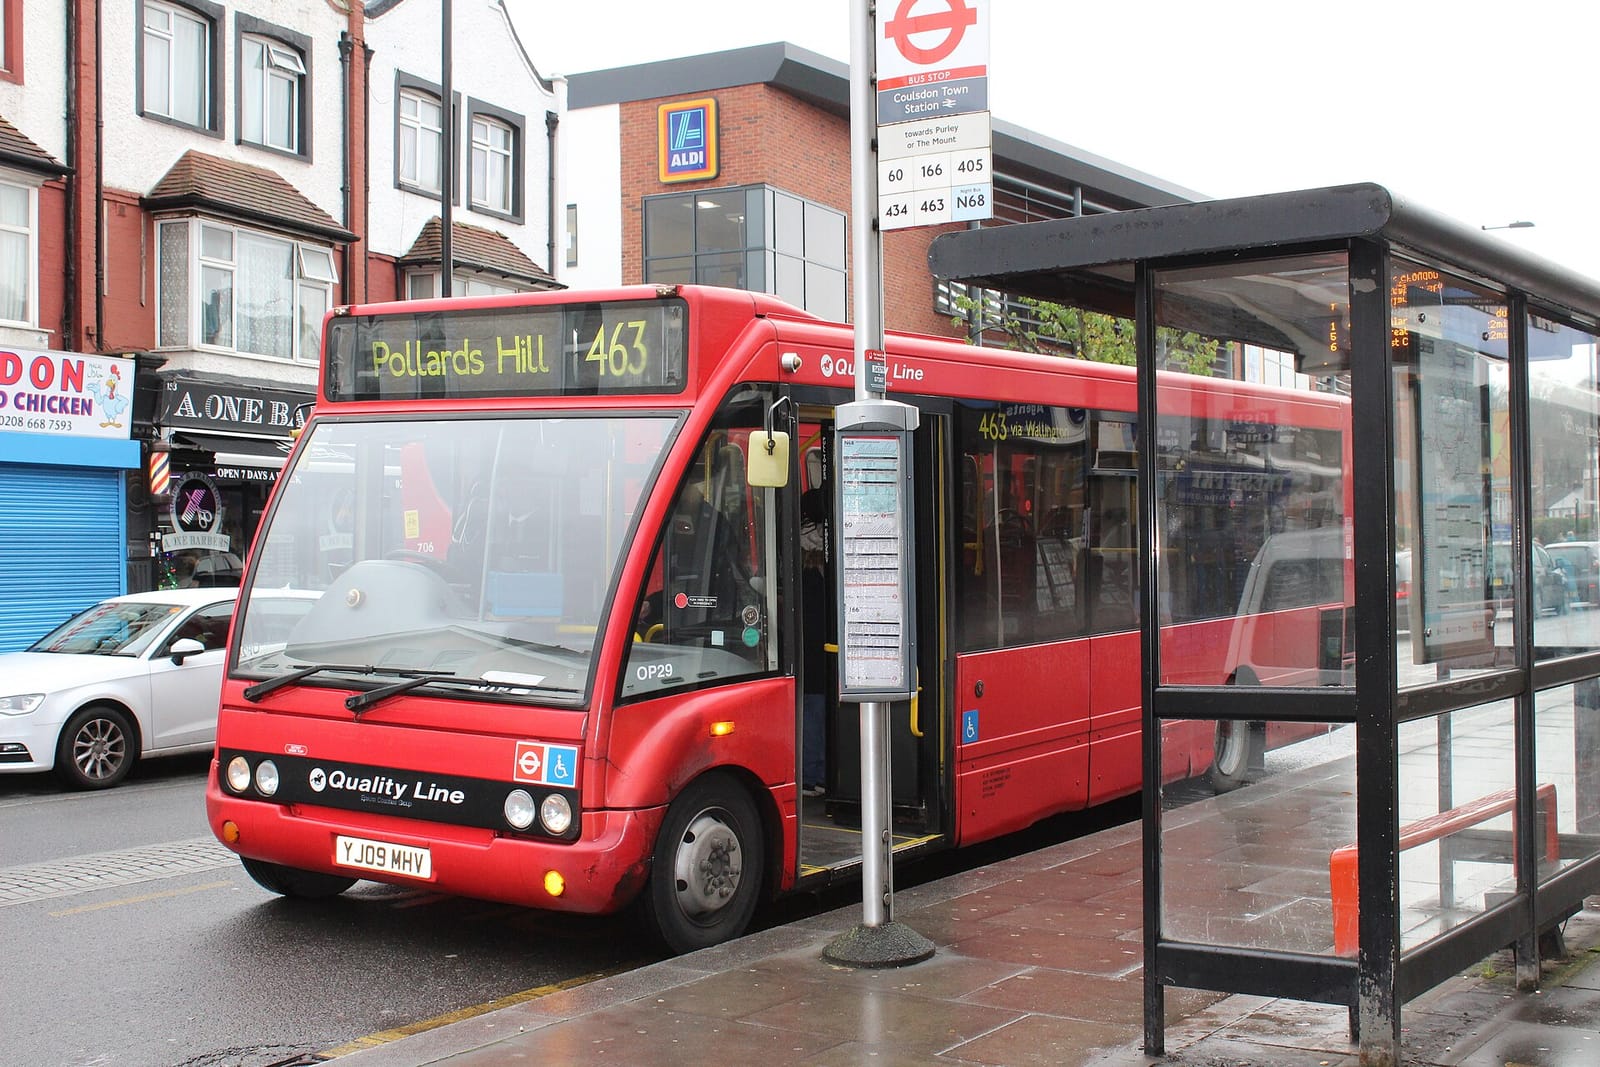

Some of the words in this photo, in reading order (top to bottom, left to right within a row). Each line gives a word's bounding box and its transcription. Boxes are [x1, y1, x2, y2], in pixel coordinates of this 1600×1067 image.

[908, 75, 925, 84] BUS
[928, 72, 951, 83] STOP
[893, 90, 939, 103] Coulsdon
[942, 85, 969, 97] Town
[905, 101, 939, 114] Station
[905, 127, 933, 138] towards
[935, 125, 959, 136] Purley
[917, 138, 930, 147] The
[932, 136, 956, 146] Mount
[671, 150, 704, 168] ALDI
[888, 169, 904, 182] 60
[921, 164, 943, 178] 166
[958, 158, 983, 173] 405
[885, 204, 908, 217] 434
[920, 198, 945, 213] 463
[957, 194, 985, 208] N68
[372, 339, 485, 377] Pollards
[496, 334, 550, 374] Hill
[585, 319, 648, 376] 463
[893, 363, 924, 381] Line
[166, 382, 177, 391] 153
[14, 391, 93, 416] CHICKEN
[267, 400, 315, 427] BA
[27, 418, 46, 429] 668
[48, 419, 72, 431] 7593
[979, 411, 1007, 440] 463
[1010, 424, 1022, 436] via
[217, 467, 239, 479] OPEN
[241, 470, 246, 479] 7
[247, 470, 267, 480] DAYS
[269, 471, 275, 480] A
[417, 542, 434, 553] 706
[636, 664, 673, 681] OP29
[328, 770, 408, 800] Quality
[413, 781, 465, 804] Line
[344, 841, 387, 867] YJ09
[391, 848, 423, 874] MHV
